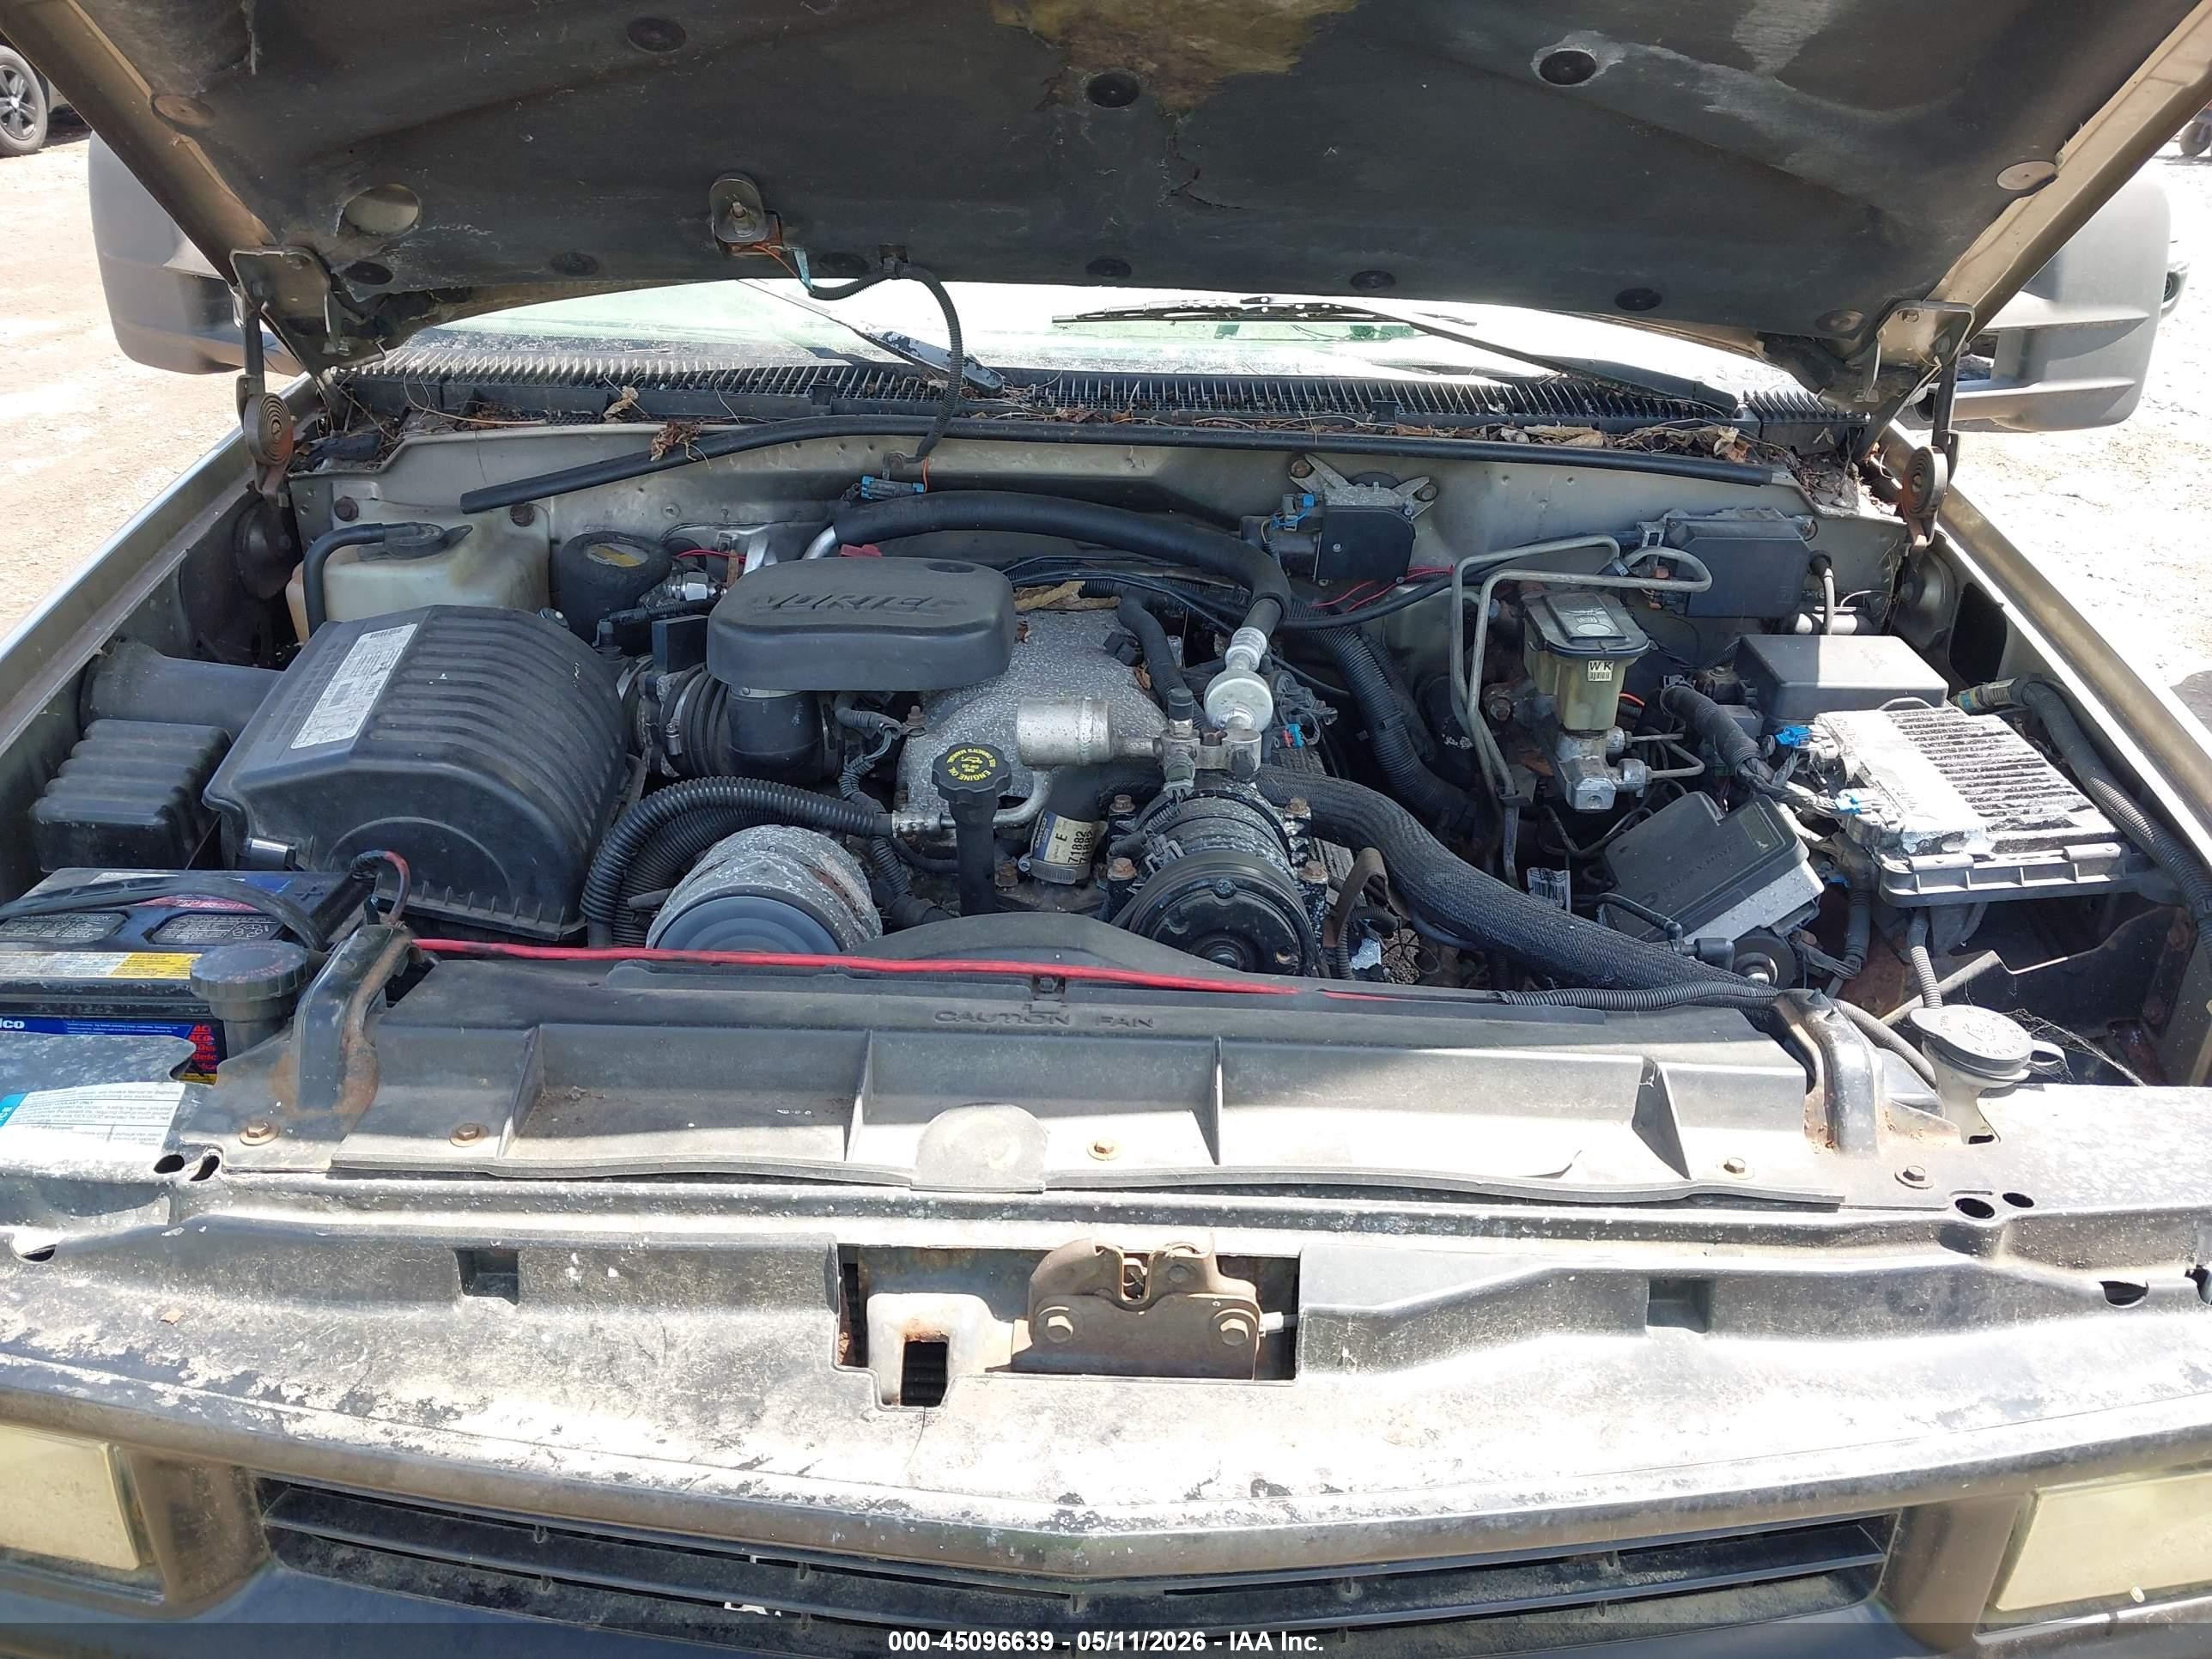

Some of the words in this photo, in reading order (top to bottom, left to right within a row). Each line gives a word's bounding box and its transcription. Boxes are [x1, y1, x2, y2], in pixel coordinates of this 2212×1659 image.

[957, 769, 992, 781] ENGINE
[1055, 833, 1068, 842] E
[1067, 830, 1086, 864] 71882
[933, 1010, 1071, 1026] CAUTION
[1095, 1015, 1154, 1029] FAN
